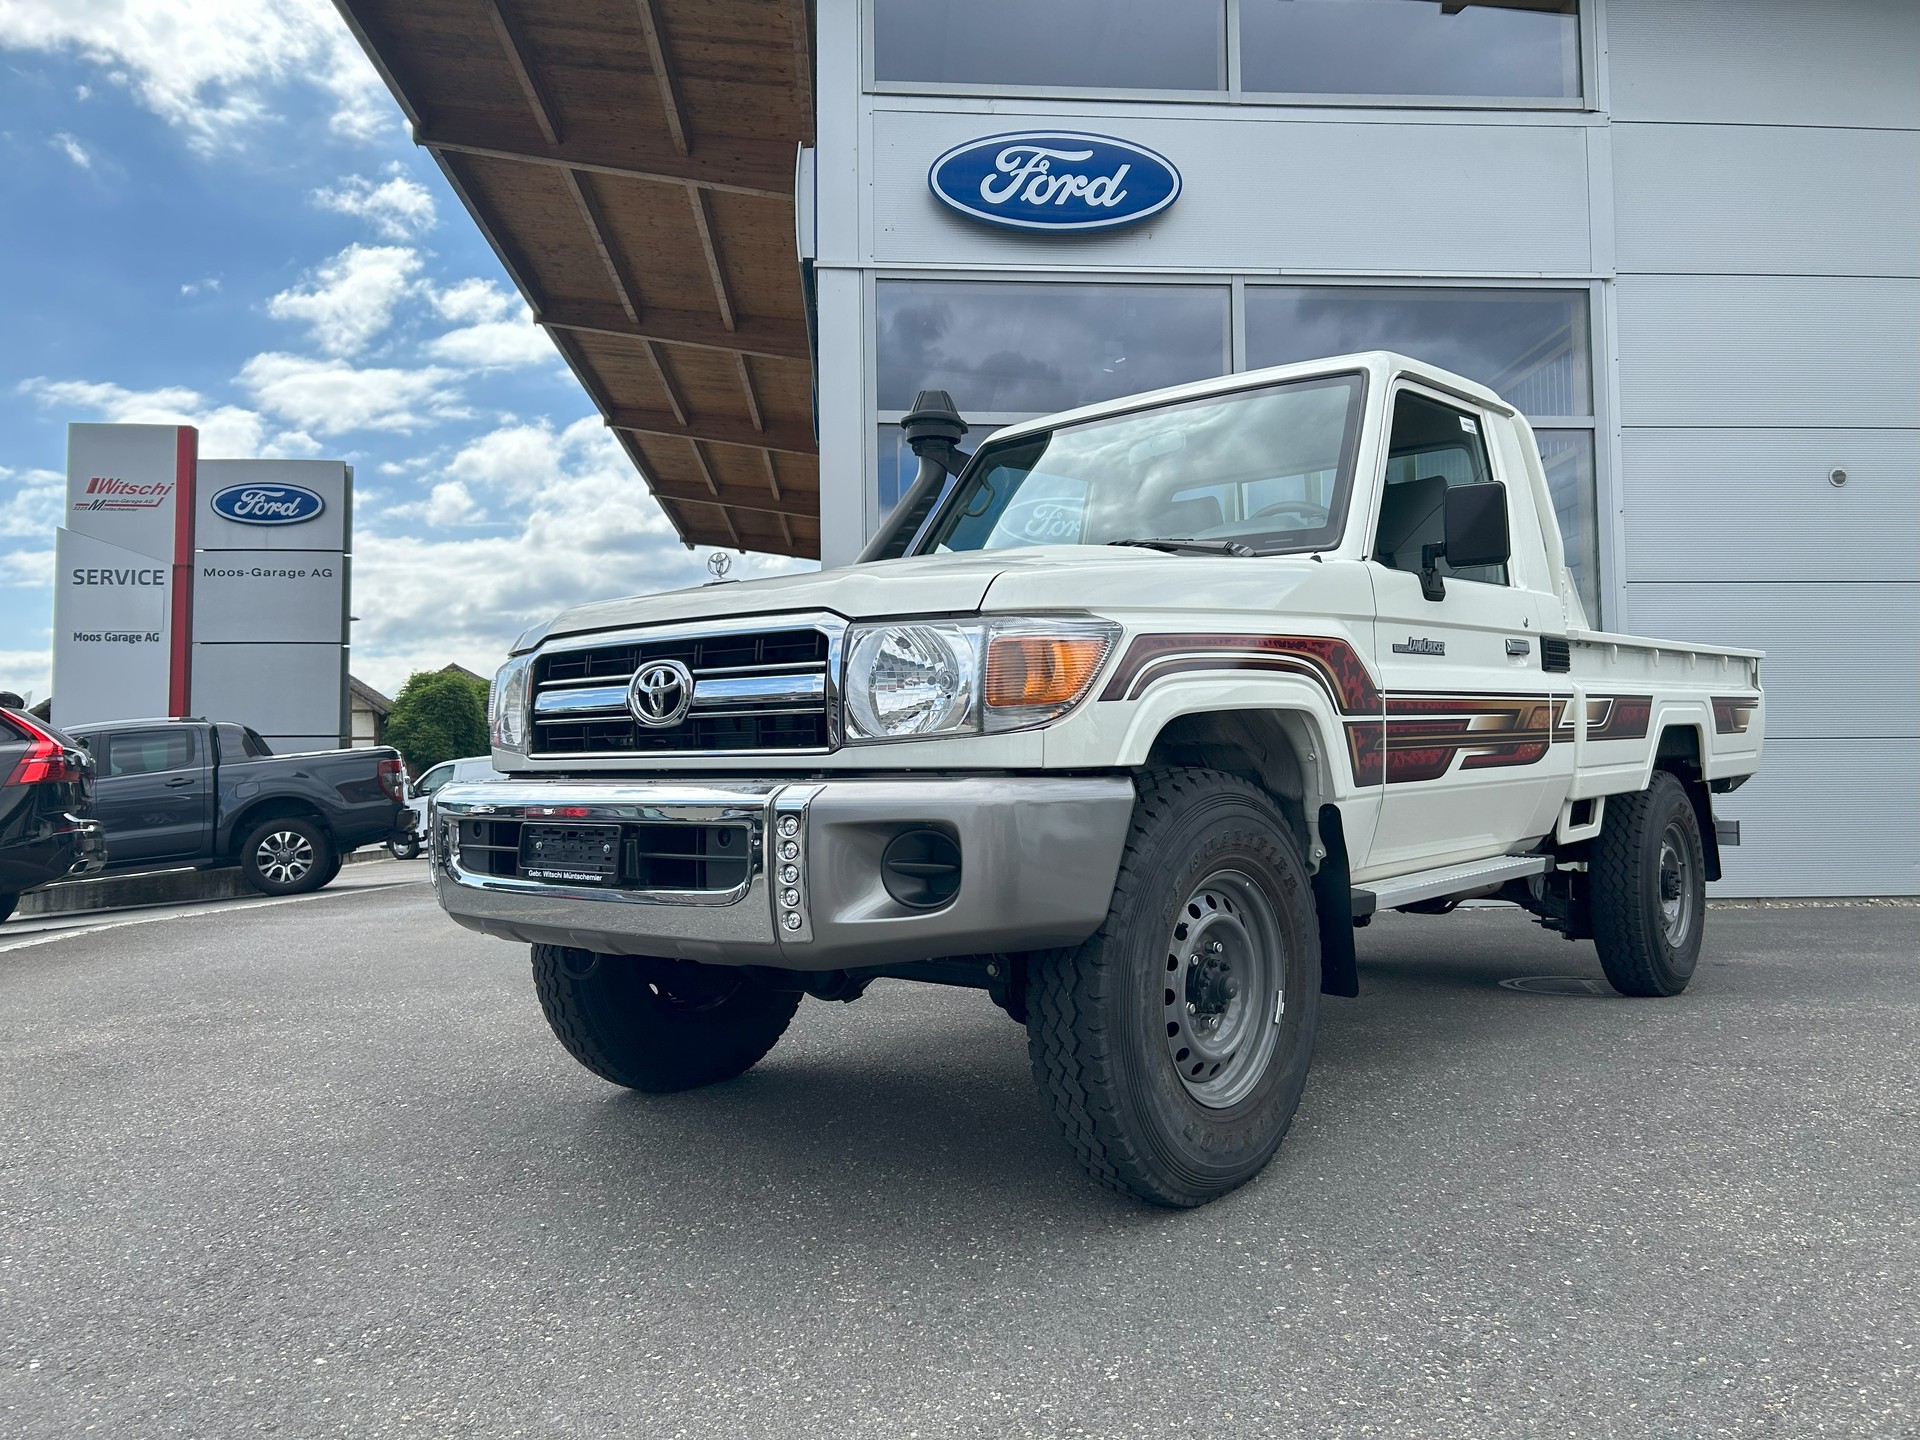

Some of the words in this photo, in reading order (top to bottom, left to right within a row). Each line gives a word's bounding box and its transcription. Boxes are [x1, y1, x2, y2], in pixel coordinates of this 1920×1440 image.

[980, 145, 1131, 207] Ford
[96, 477, 175, 496] Witschi
[233, 489, 302, 516] Ford
[72, 568, 165, 586] SERVICE
[203, 567, 306, 579] Moos-Garage
[310, 568, 333, 578] AG
[73, 632, 102, 642] Moos
[104, 632, 142, 644] Garage
[144, 632, 160, 642] AG
[542, 870, 562, 879] Witschi
